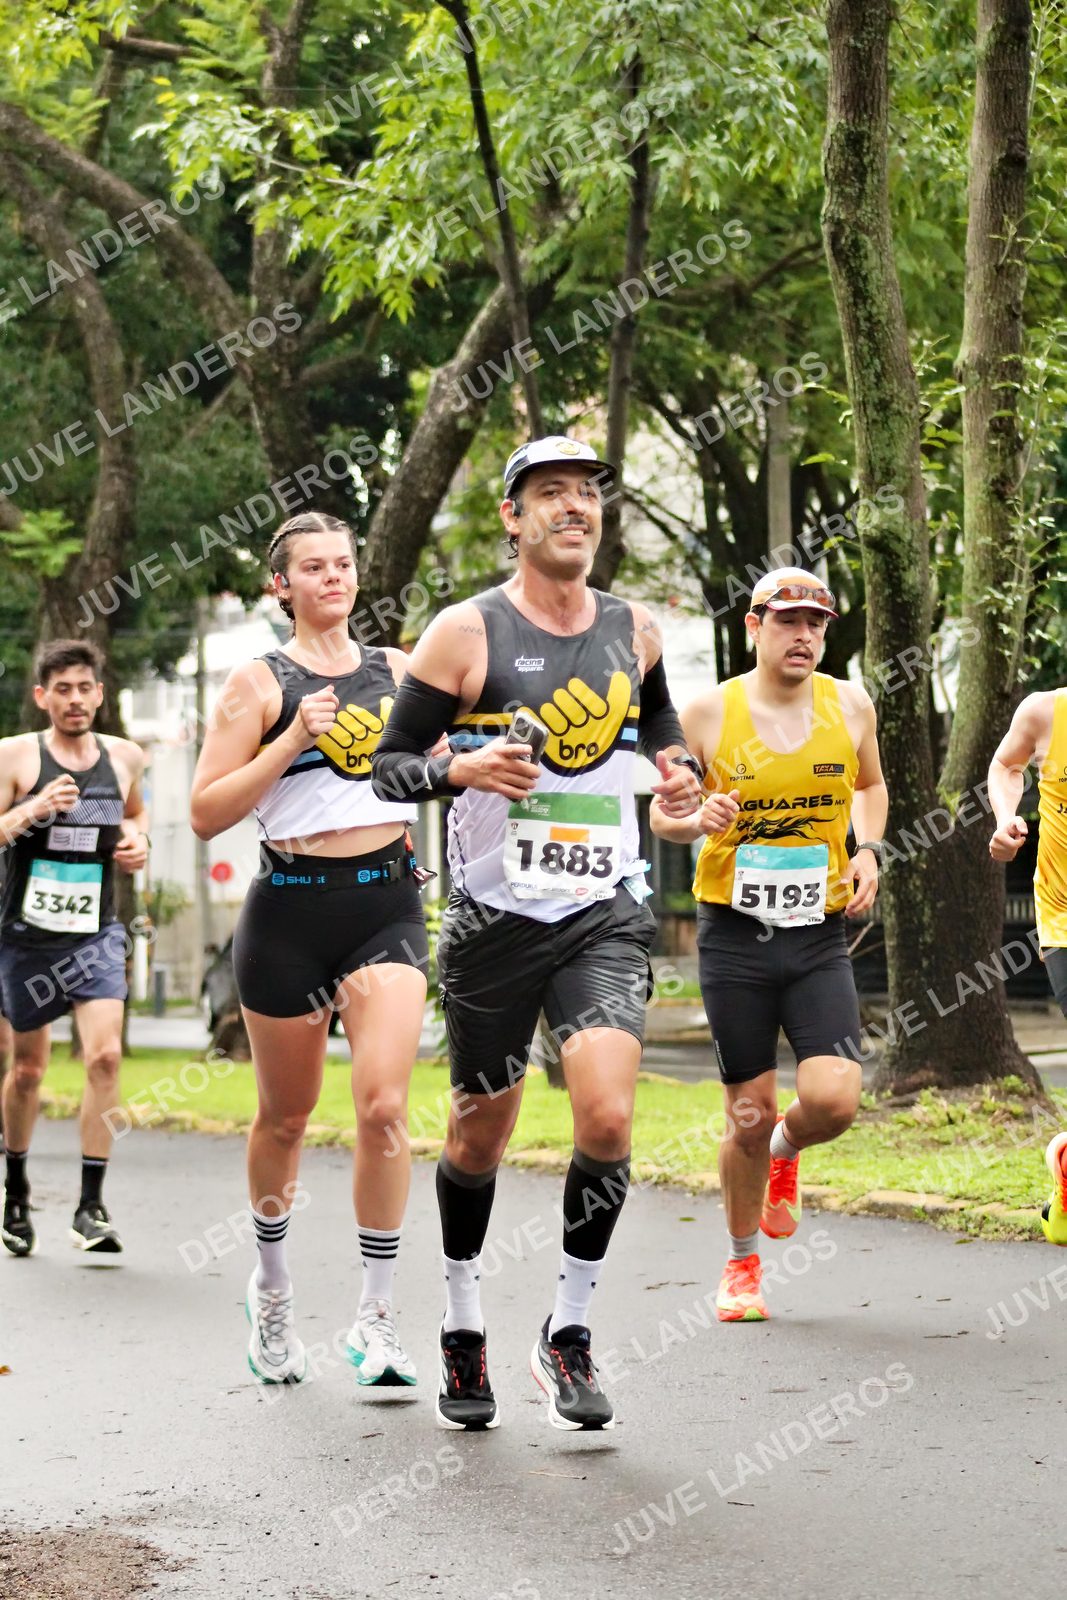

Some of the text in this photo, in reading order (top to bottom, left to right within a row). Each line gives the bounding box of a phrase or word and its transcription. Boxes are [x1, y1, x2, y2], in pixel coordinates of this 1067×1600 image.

[559, 738, 599, 760] bro
[517, 838, 613, 879] 1883
[31, 890, 94, 915] 3342
[739, 882, 820, 910] 5193
